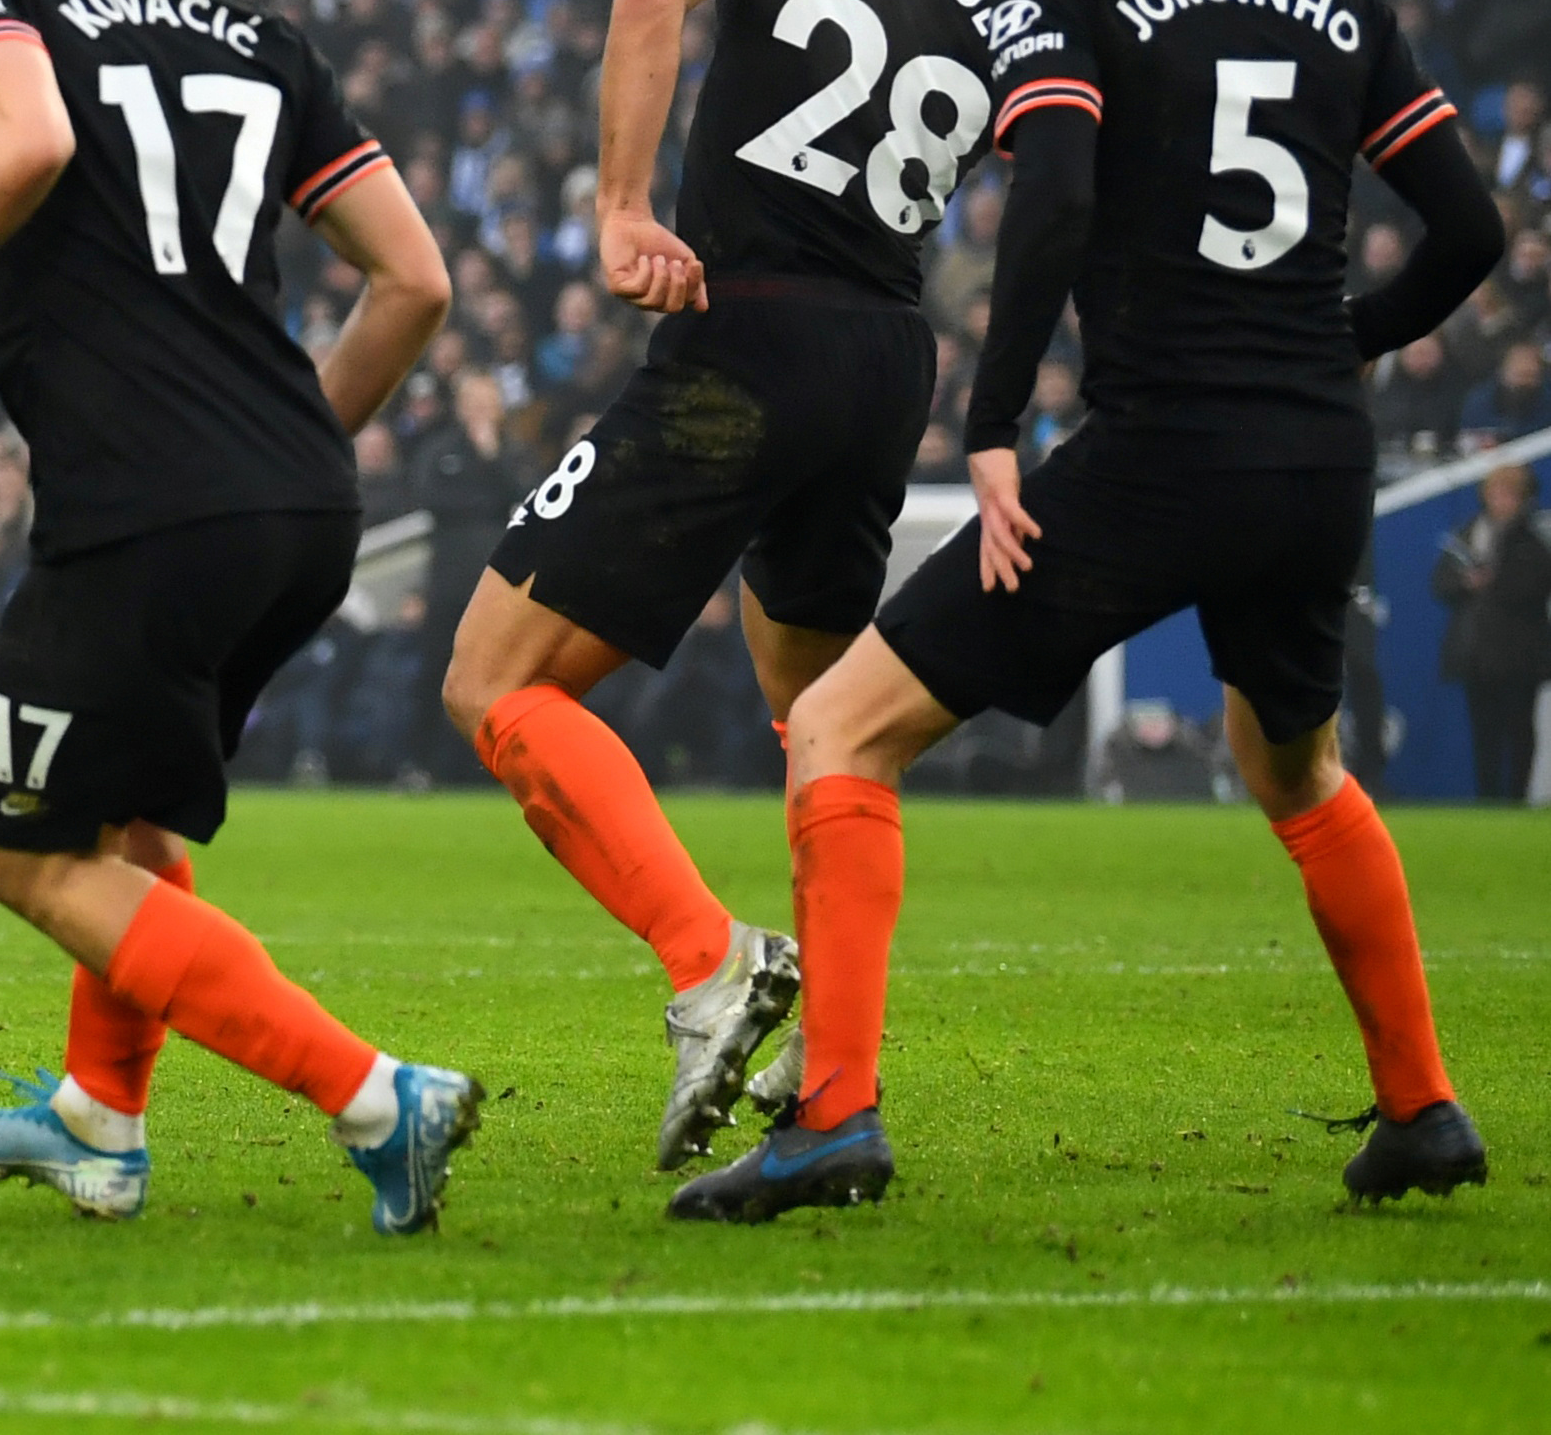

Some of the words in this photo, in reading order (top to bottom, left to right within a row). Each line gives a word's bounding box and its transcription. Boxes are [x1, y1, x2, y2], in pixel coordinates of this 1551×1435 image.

[991, 31, 1065, 82] UNDAI
[99, 64, 283, 285] 17
[1197, 59, 1310, 271] 5
[506, 440, 596, 529] 8
